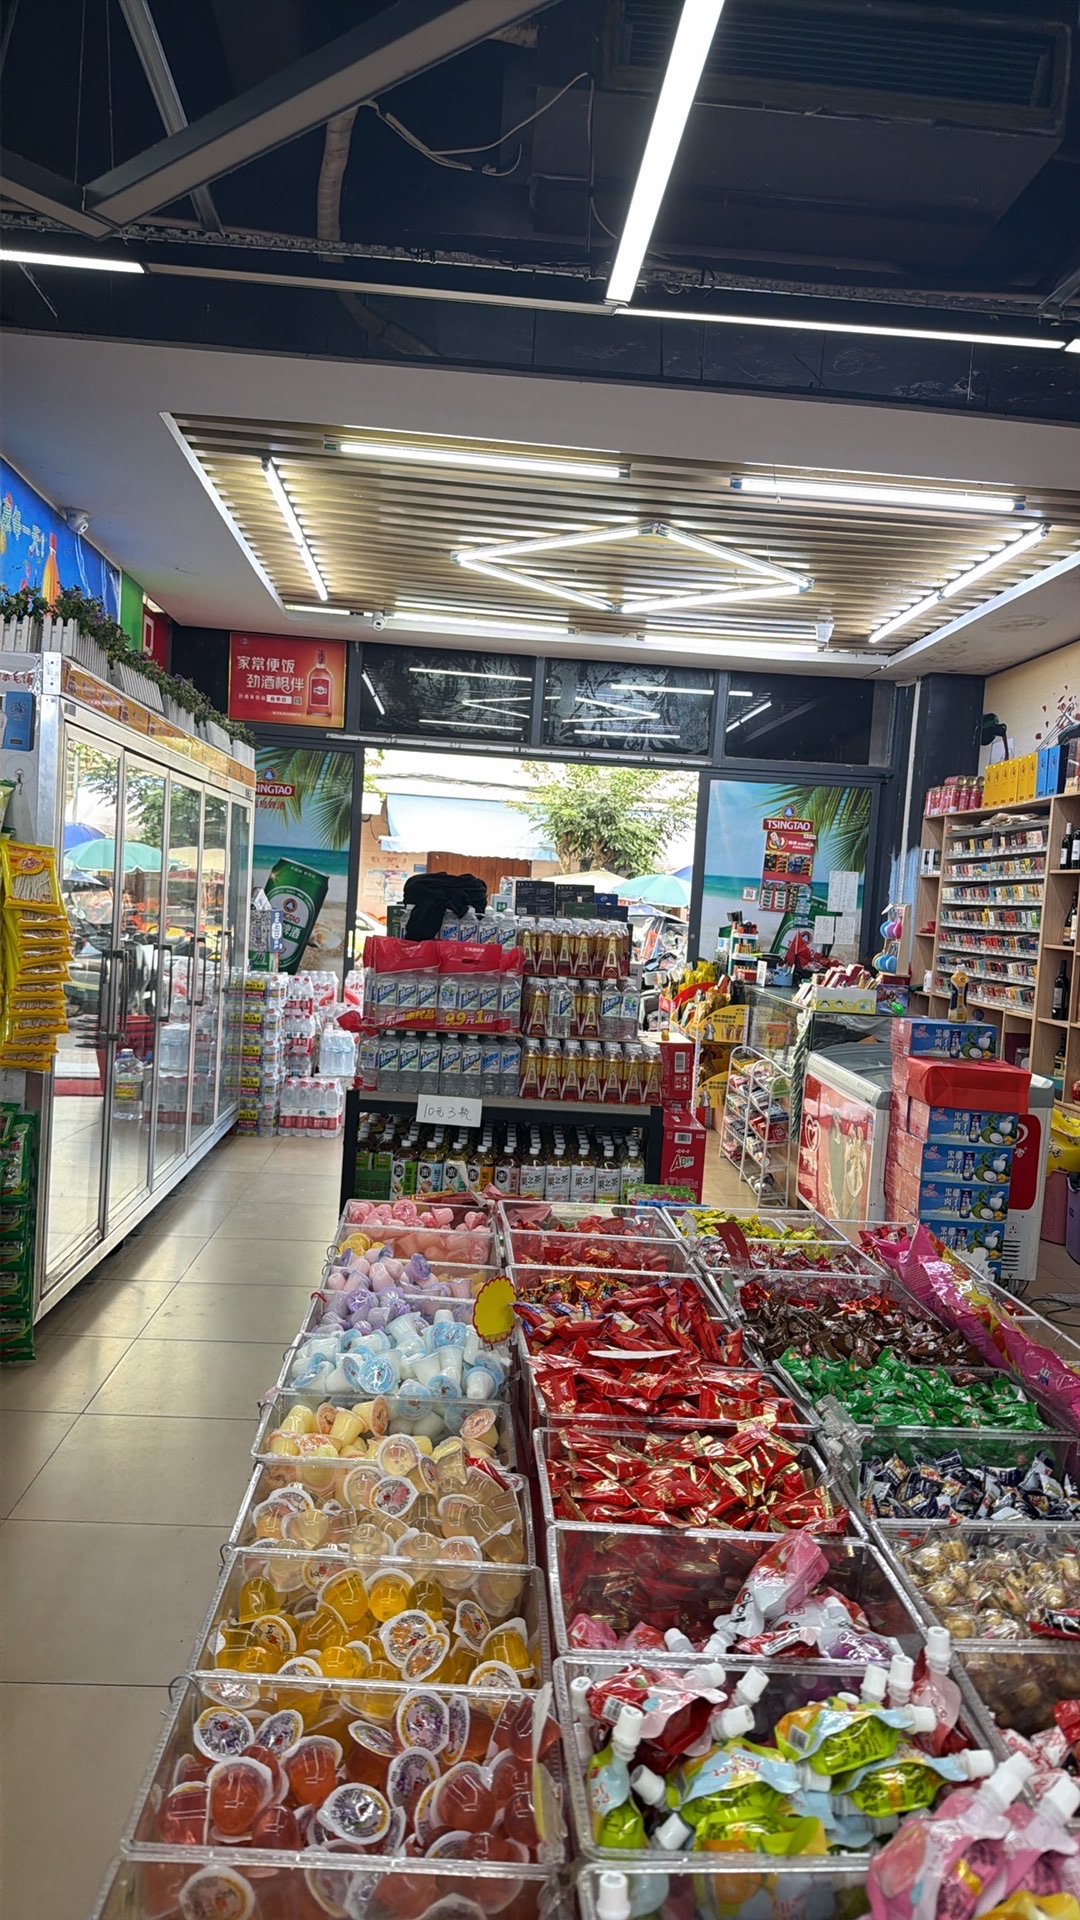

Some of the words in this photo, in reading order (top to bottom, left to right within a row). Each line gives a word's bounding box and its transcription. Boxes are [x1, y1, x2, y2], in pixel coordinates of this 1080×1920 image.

[237, 655, 296, 674] 家常便饭
[246, 673, 305, 694] 劲酒相伴
[256, 784, 293, 796] INGTAO
[766, 819, 811, 831] TSINGTAO
[423, 1102, 473, 1121] 10元3瓶
[521, 1174, 542, 1187] 果之茶
[547, 1174, 569, 1187] 果之茶
[575, 1174, 596, 1187] 果之茶
[597, 1177, 619, 1190] 果之茶
